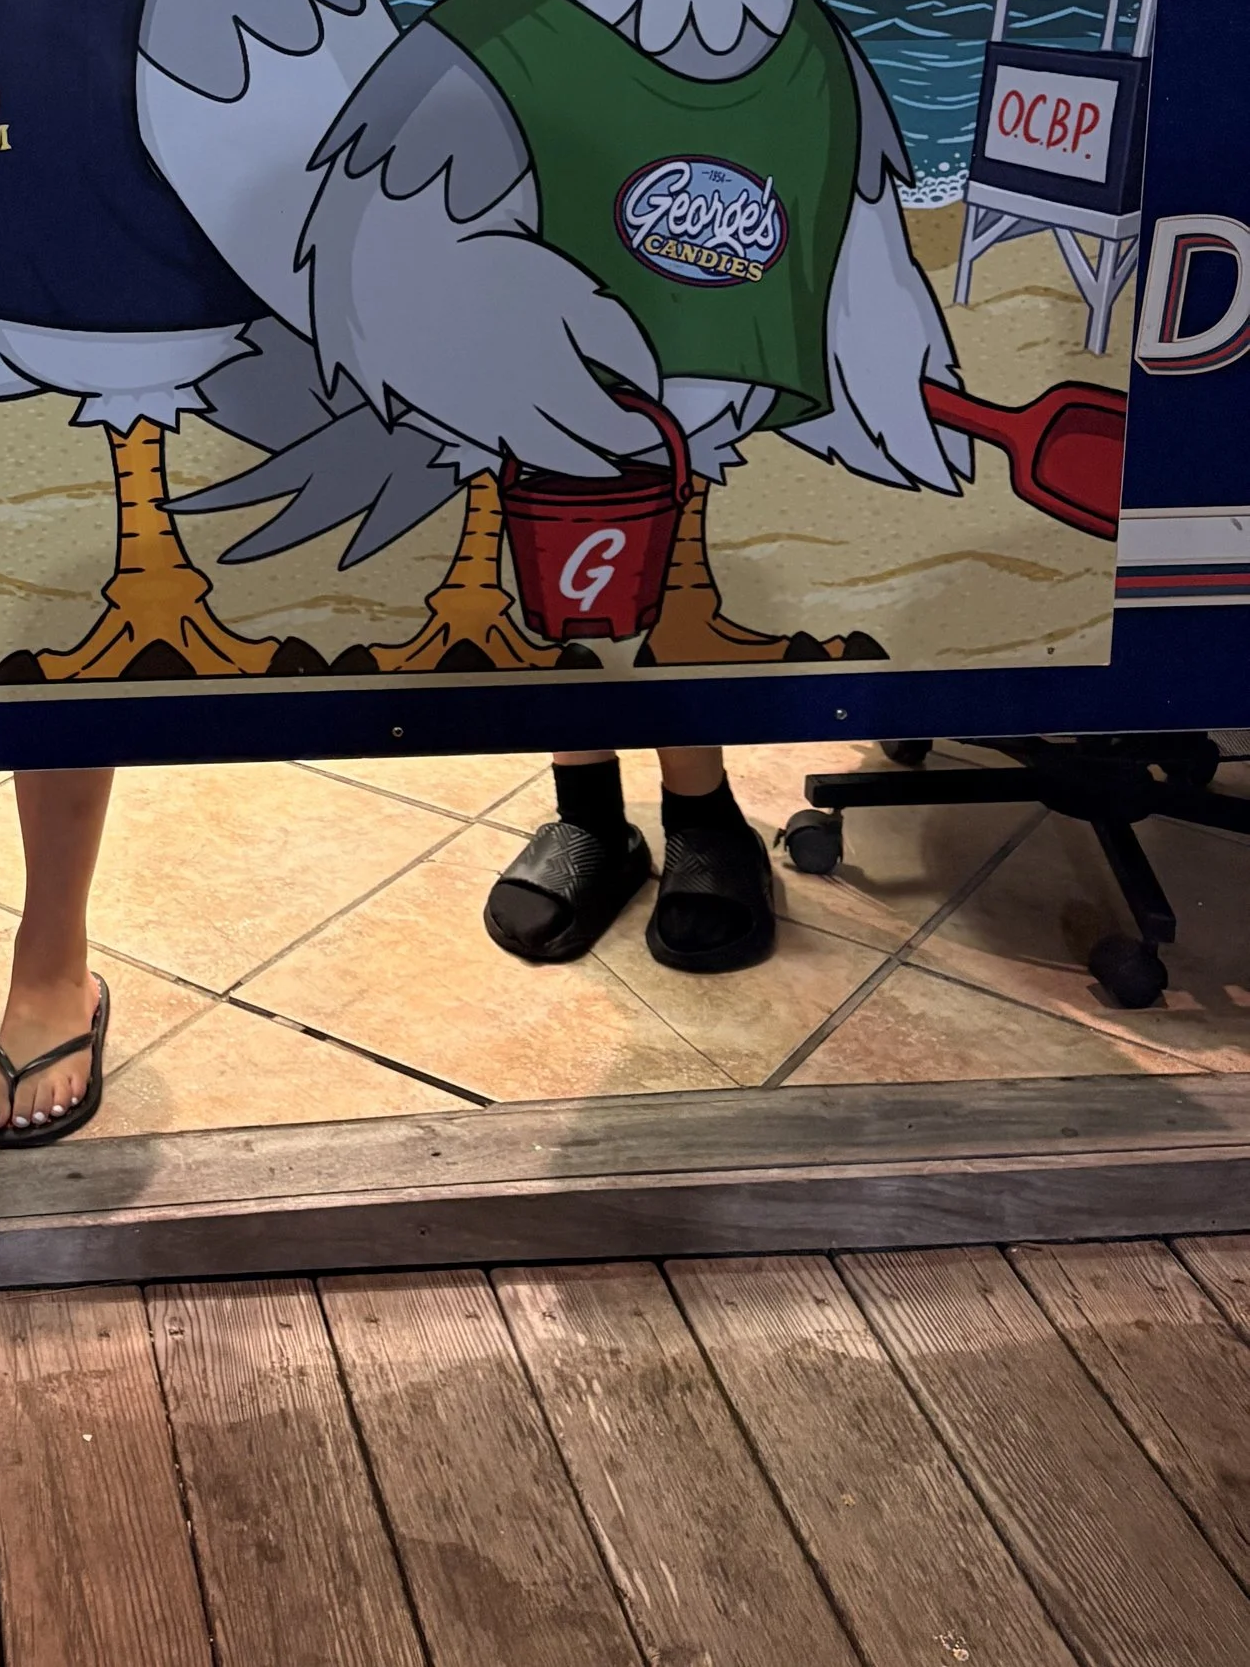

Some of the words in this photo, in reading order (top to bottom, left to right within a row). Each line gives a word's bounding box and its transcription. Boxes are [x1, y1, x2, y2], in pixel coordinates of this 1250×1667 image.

[624, 161, 776, 249] George's
[643, 234, 765, 282] CANDIES
[558, 528, 627, 612] G
